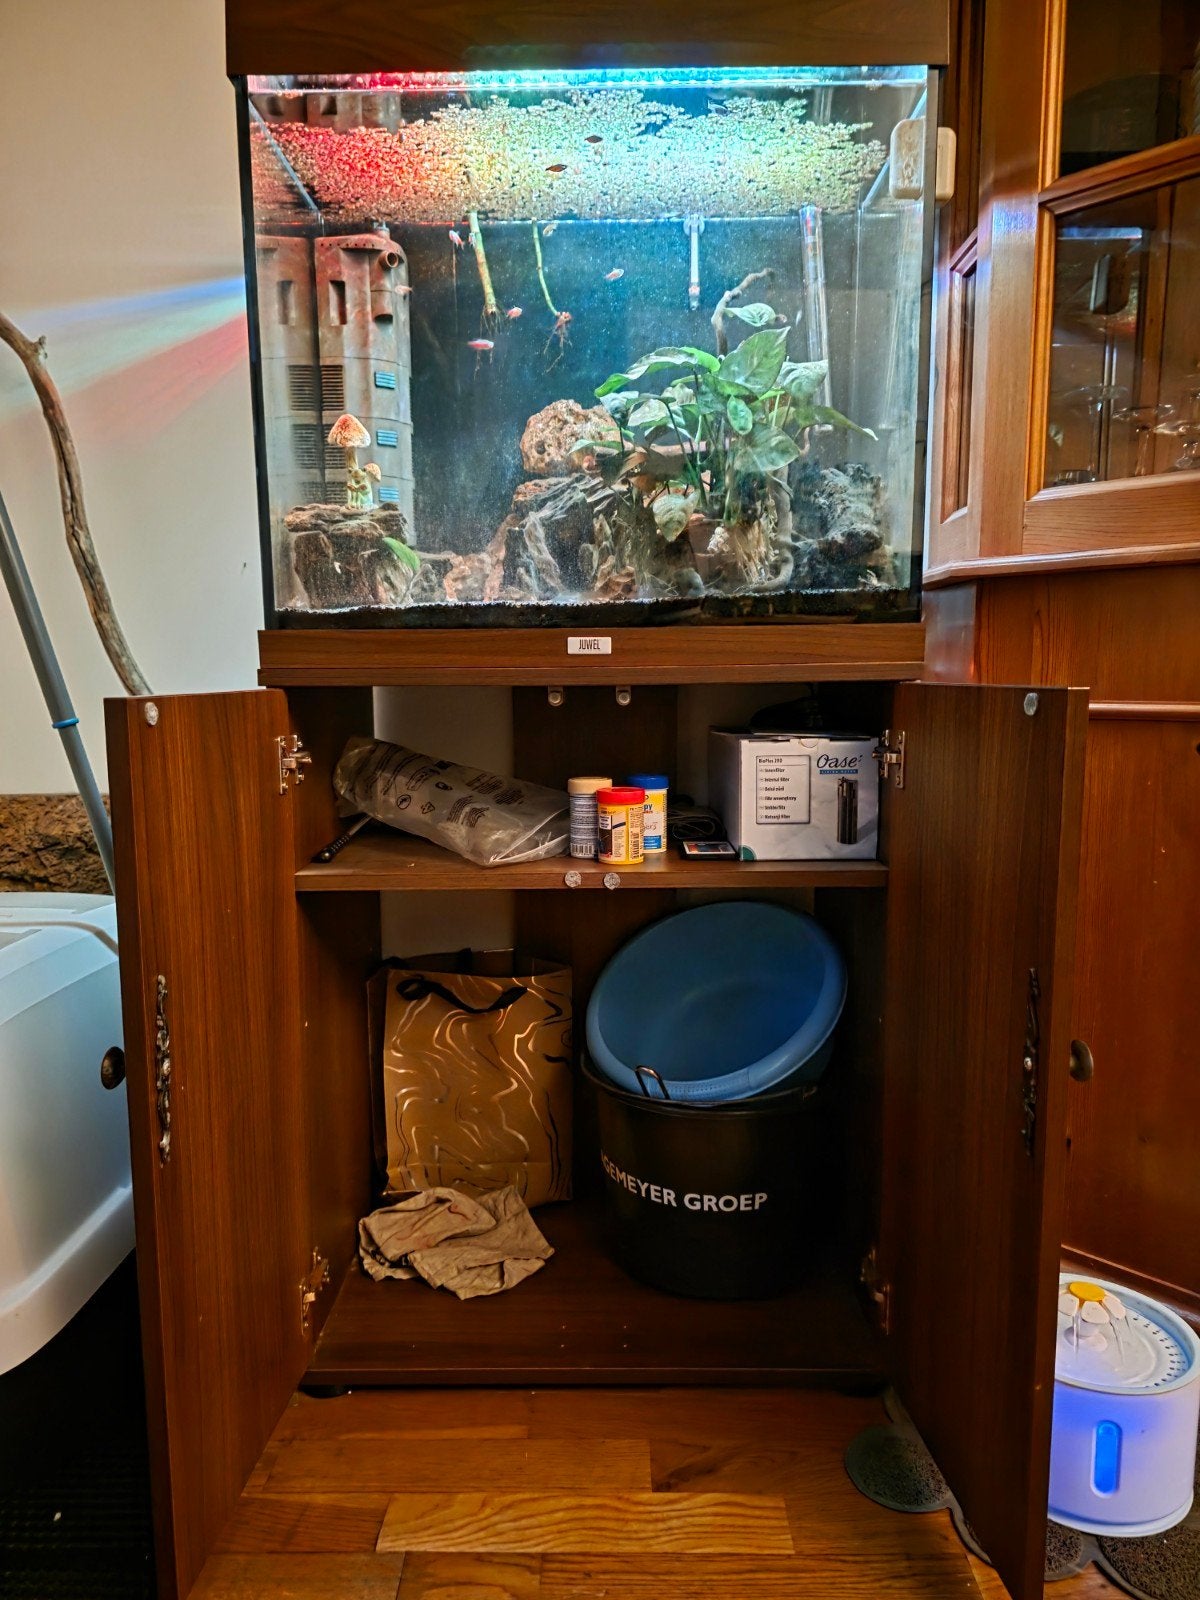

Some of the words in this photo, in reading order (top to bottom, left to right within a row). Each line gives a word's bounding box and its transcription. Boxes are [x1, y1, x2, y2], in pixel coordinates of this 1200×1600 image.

[579, 639, 601, 650] JUWEL
[816, 754, 858, 769] Oase
[600, 1149, 678, 1208] GEMEYER
[683, 1192, 769, 1212] GROEP
